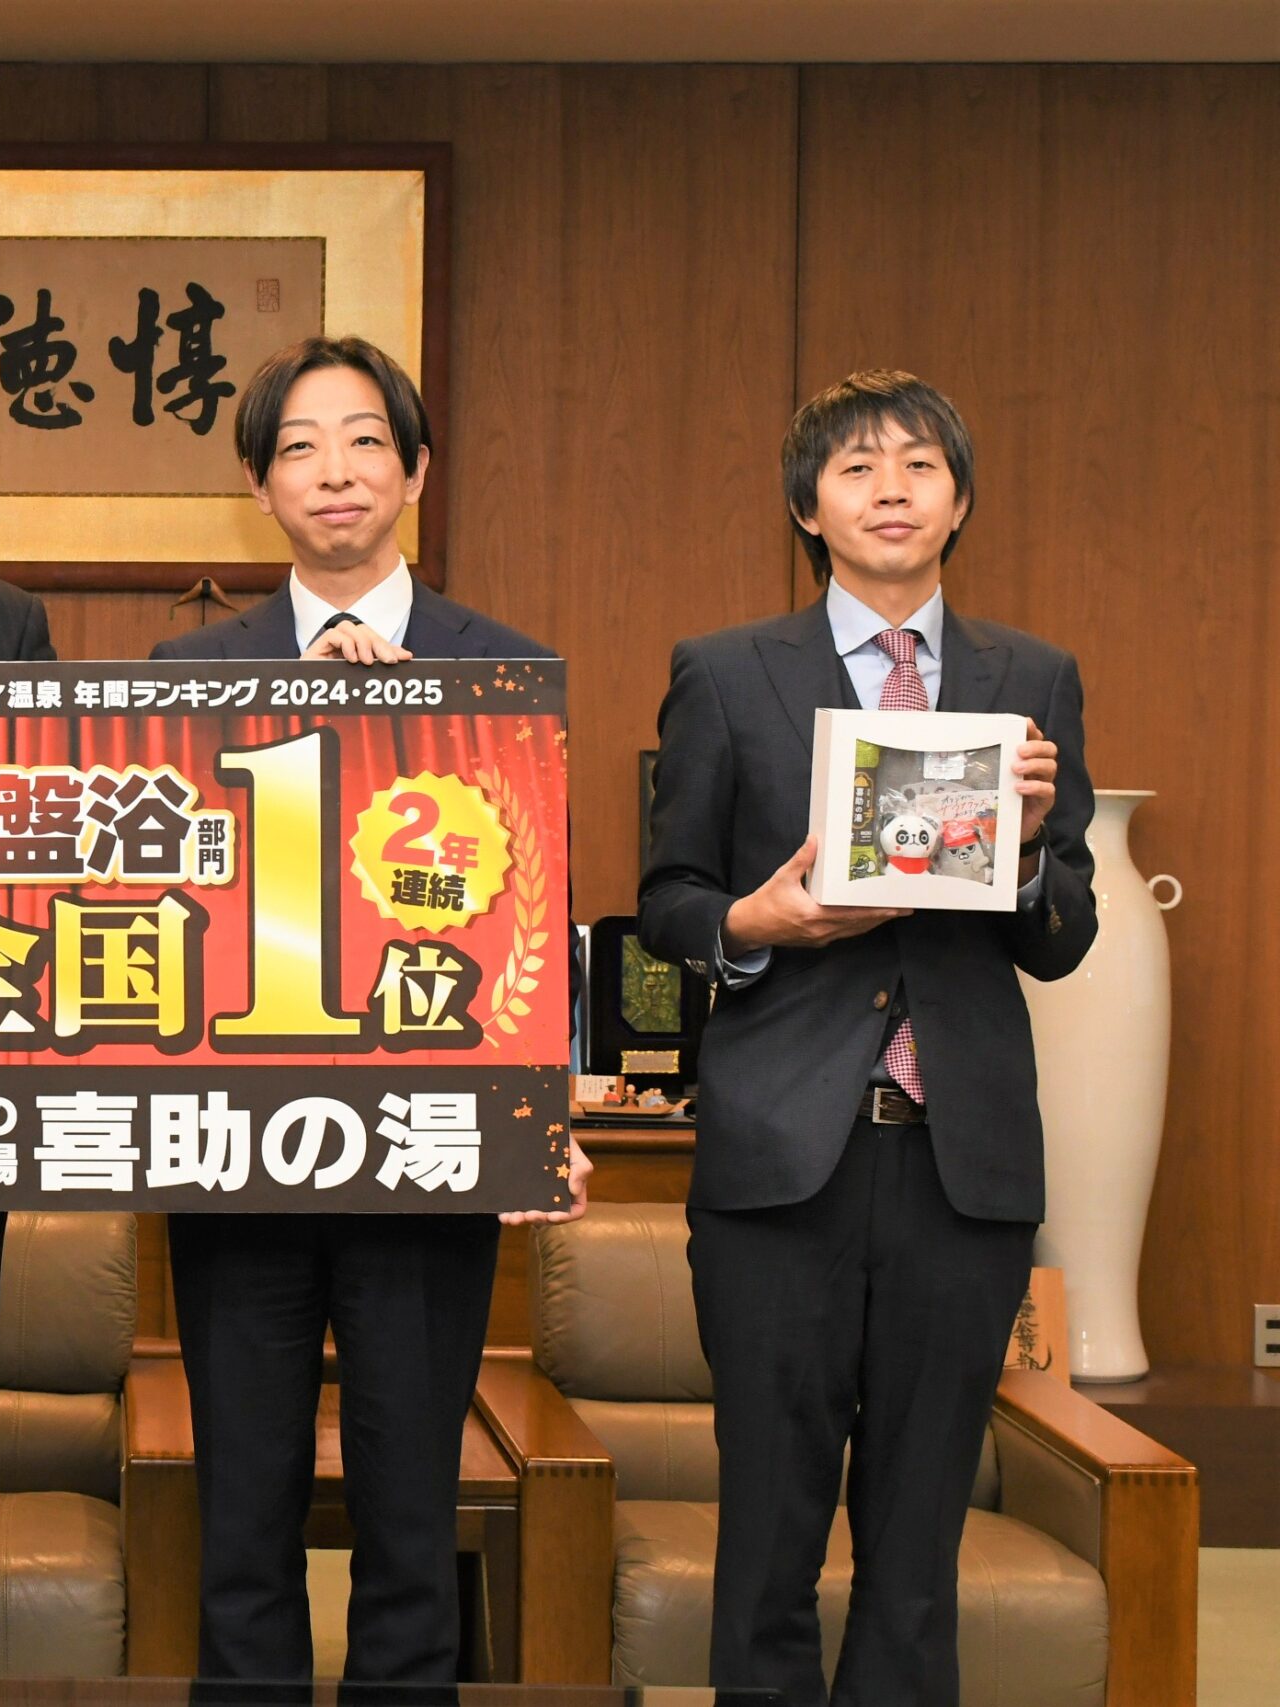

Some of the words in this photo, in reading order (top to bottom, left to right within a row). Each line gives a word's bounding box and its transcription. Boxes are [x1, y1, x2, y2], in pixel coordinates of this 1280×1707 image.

[74, 678, 260, 709] 年間ランキング
[196, 817, 227, 877] 部門
[379, 791, 480, 874] 2年
[389, 868, 468, 912] 連続
[33, 1090, 483, 1193] 喜助の湯
